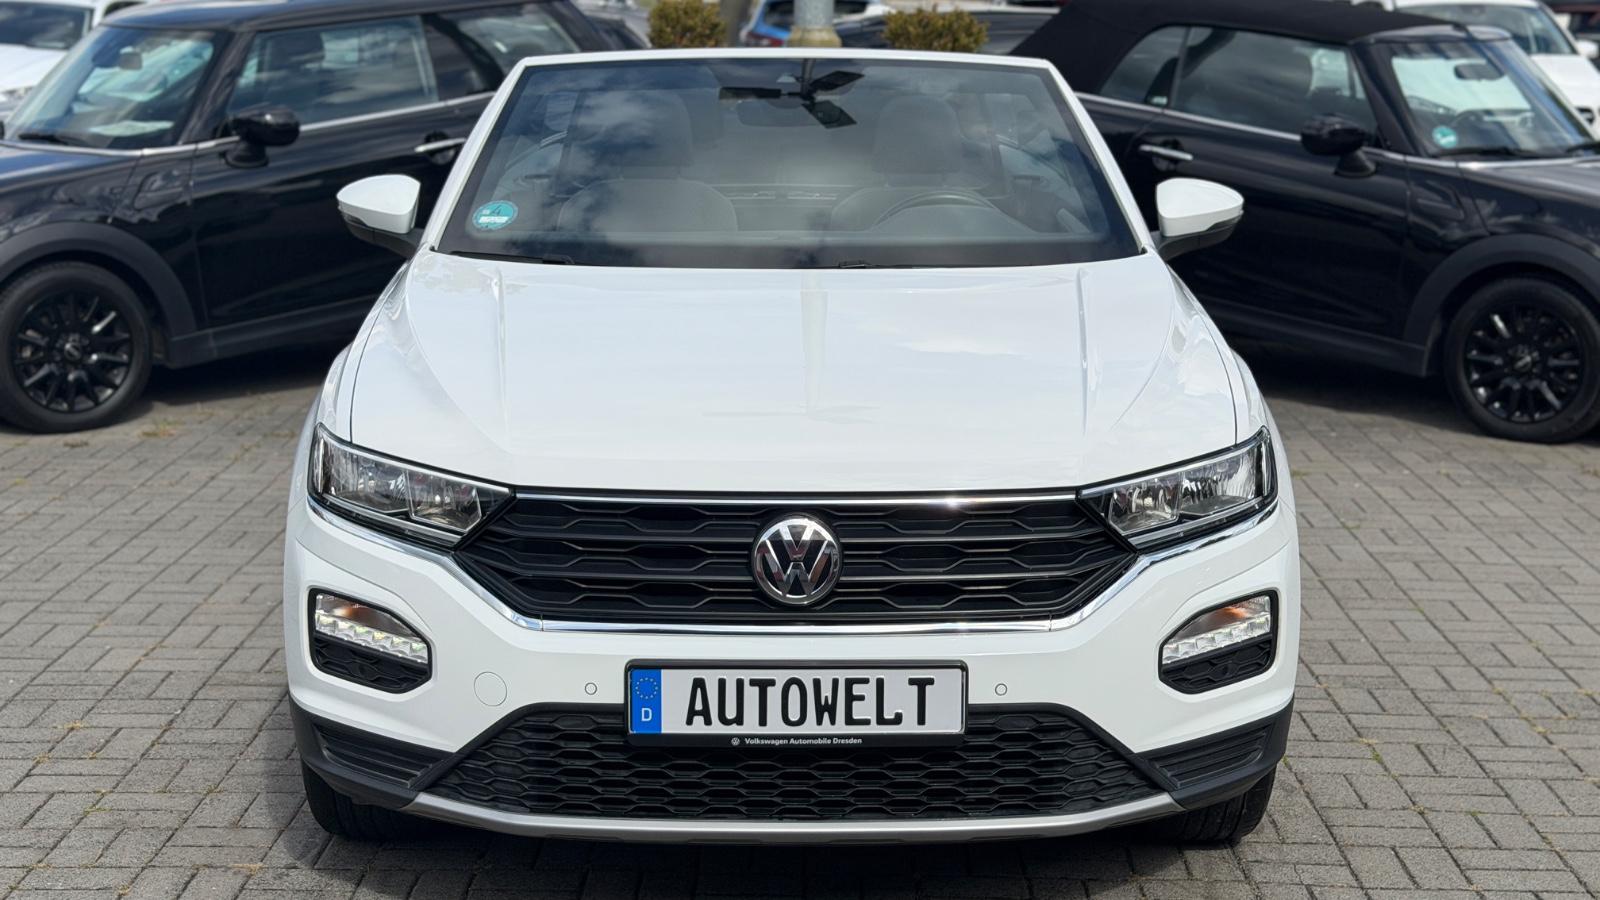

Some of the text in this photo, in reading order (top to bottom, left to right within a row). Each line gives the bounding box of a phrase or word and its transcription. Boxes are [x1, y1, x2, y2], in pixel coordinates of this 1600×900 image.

[755, 518, 840, 605] VW
[641, 707, 653, 722] D
[685, 676, 935, 727] AUTOWELT
[744, 737, 788, 746] Volkswagen
[789, 737, 832, 745] Automobile
[832, 737, 863, 745] Dresden
